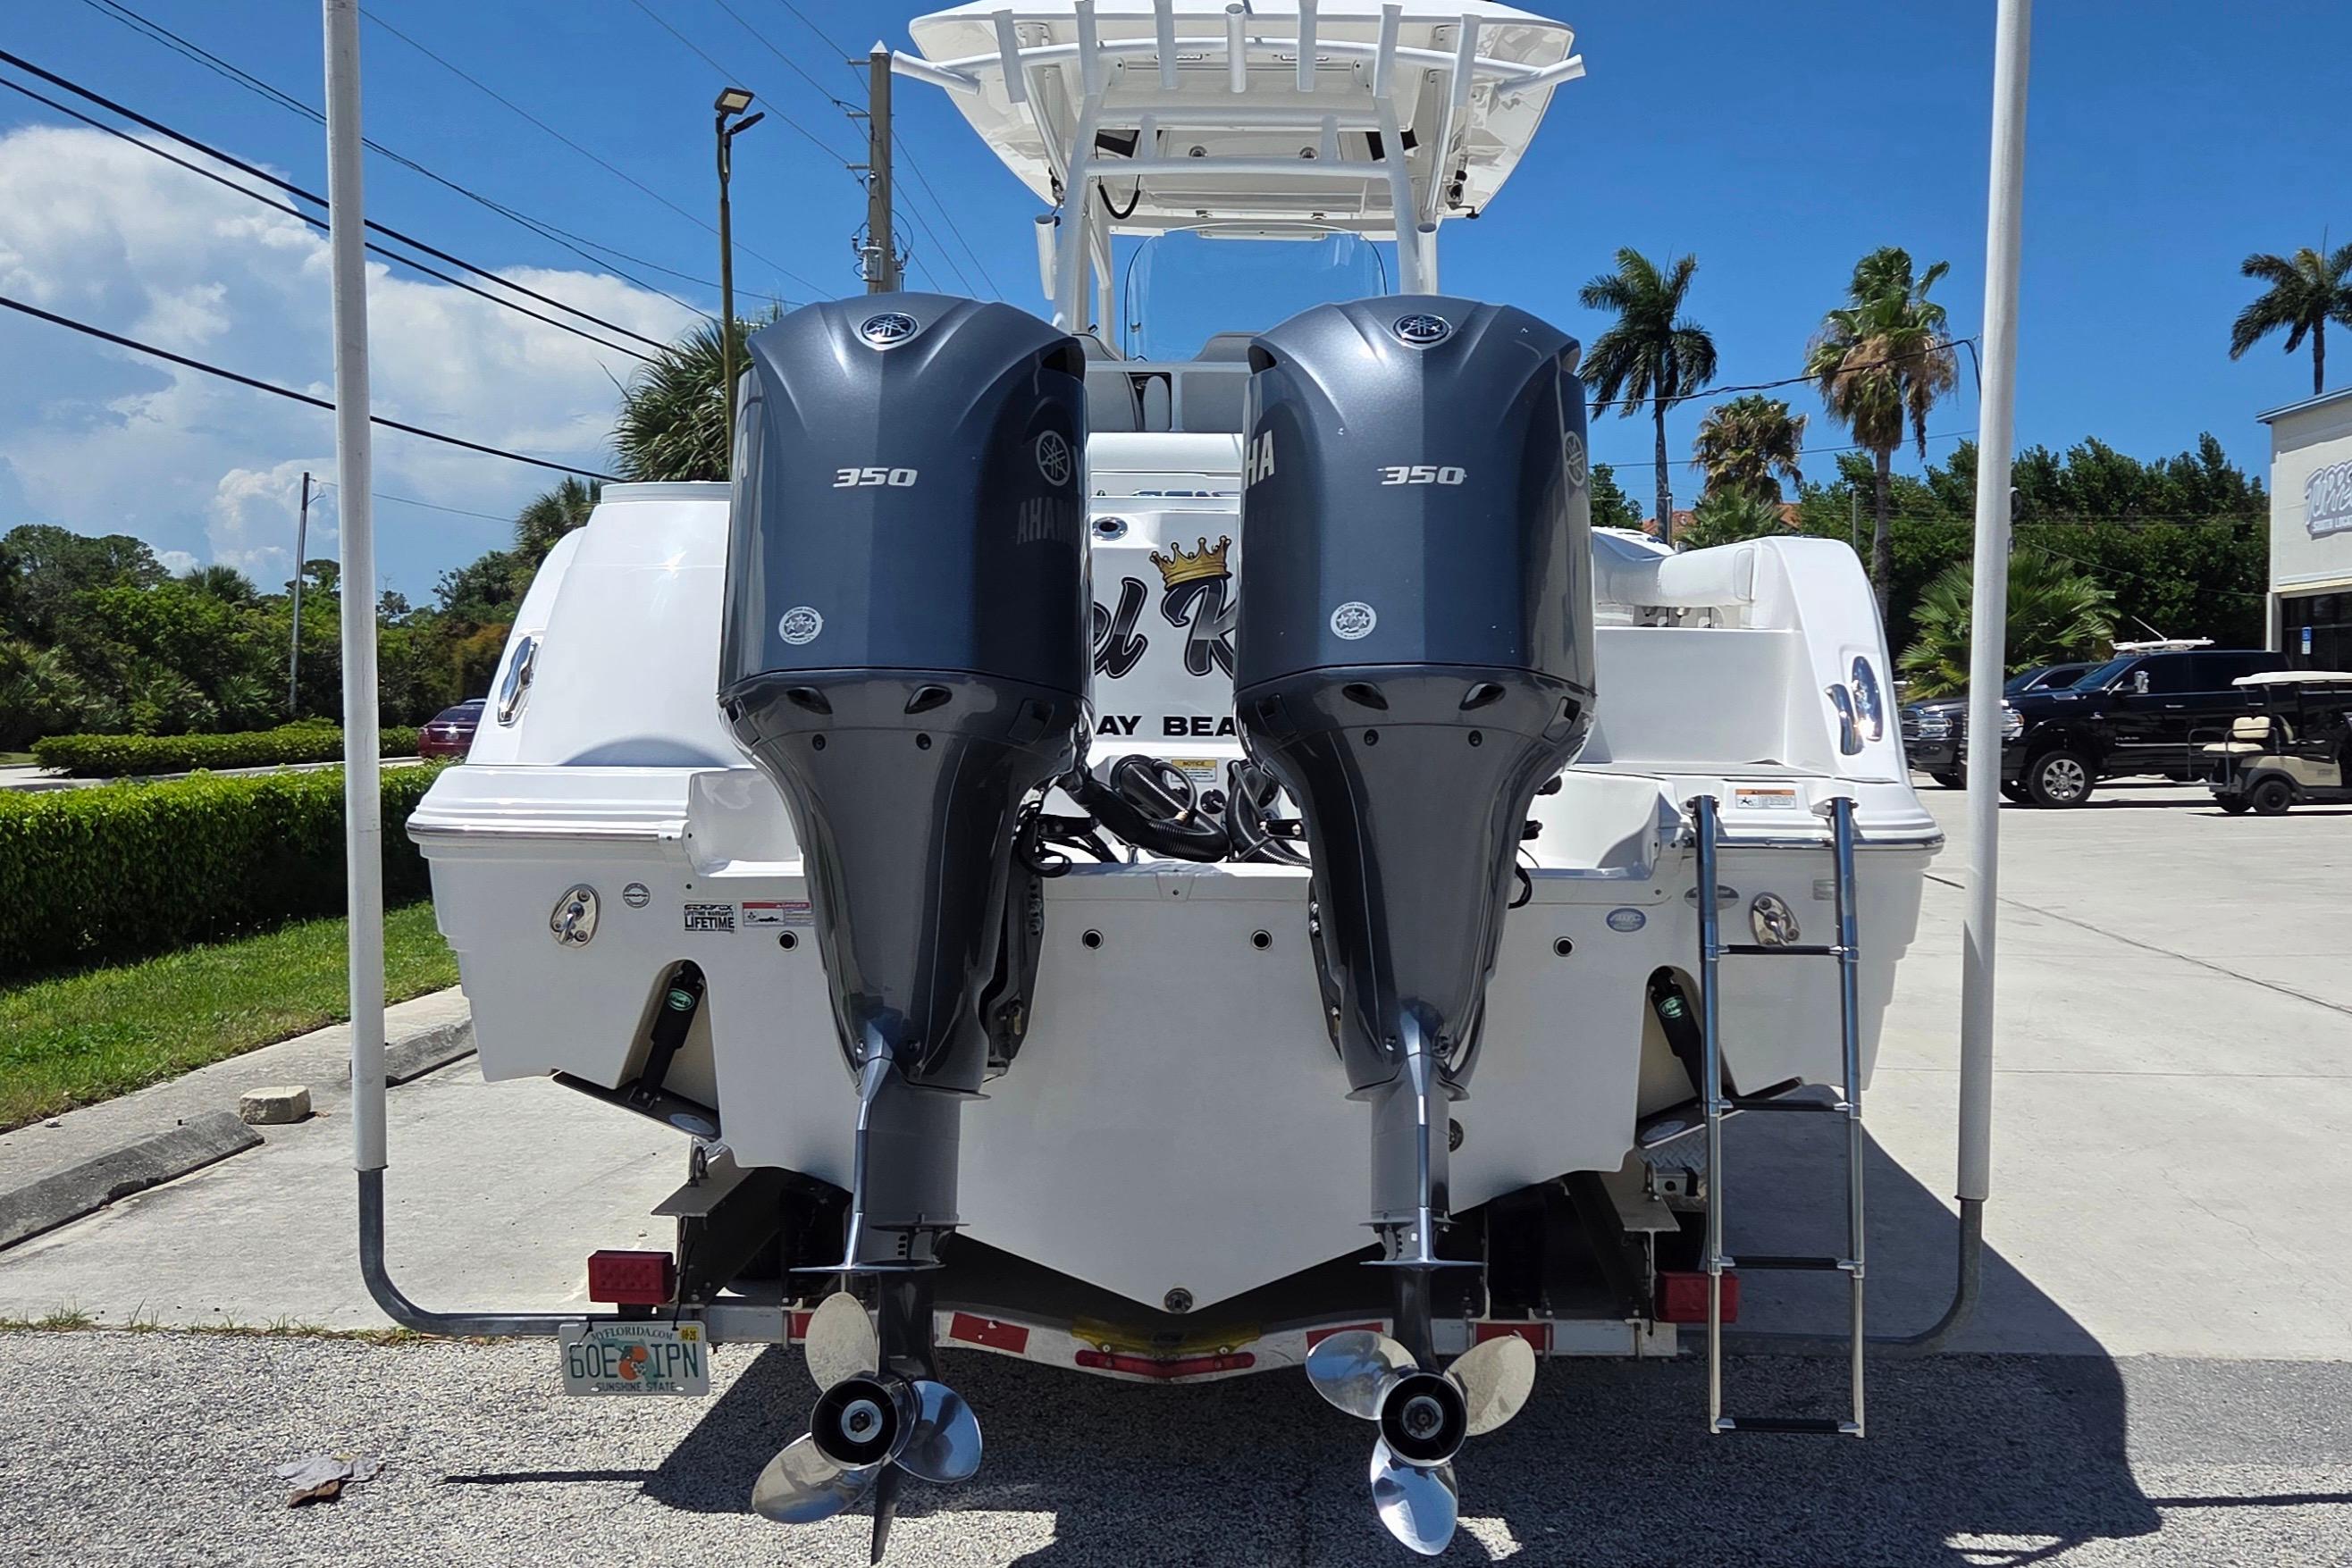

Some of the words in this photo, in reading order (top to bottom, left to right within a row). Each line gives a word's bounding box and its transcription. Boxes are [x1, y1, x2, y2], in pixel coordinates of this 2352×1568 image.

[833, 467, 918, 487] 350
[1381, 465, 1466, 485] 350
[685, 916, 735, 928] LIFETIME
[591, 1326, 673, 1341] MYFLORIDA.COM
[651, 1343, 699, 1379] IPN
[595, 1382, 642, 1392] SUNSHINE
[645, 1381, 676, 1392] STATE
